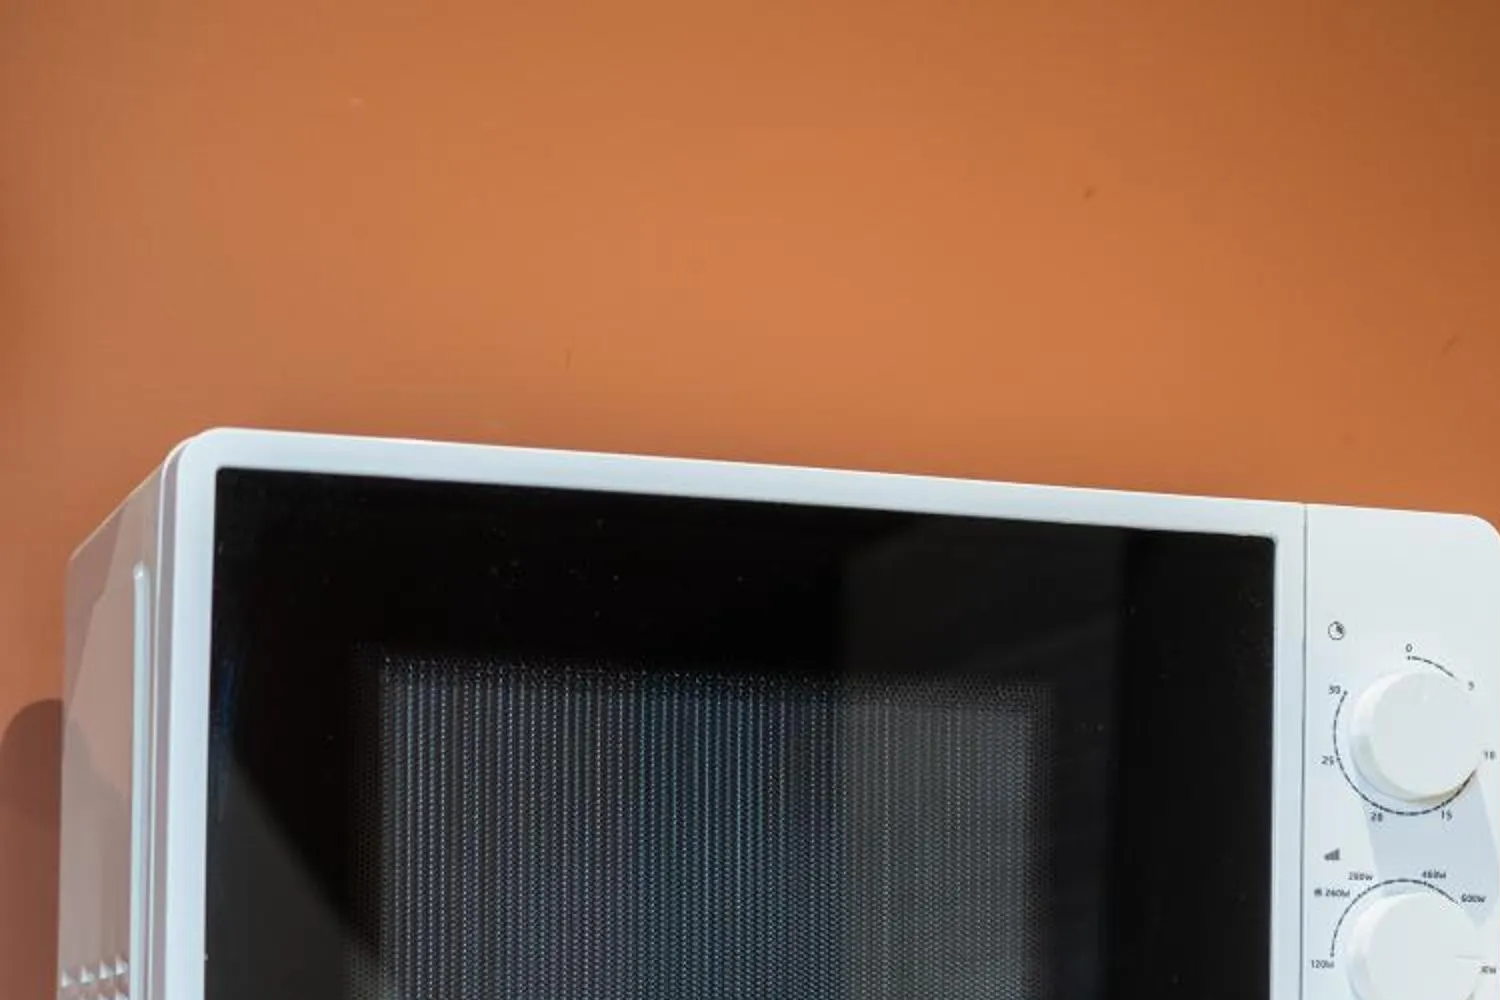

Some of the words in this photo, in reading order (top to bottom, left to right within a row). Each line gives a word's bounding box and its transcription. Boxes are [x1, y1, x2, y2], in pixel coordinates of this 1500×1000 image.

[1405, 643, 1413, 653] 0
[1321, 755, 1334, 766] 25
[1440, 811, 1452, 821] 15
